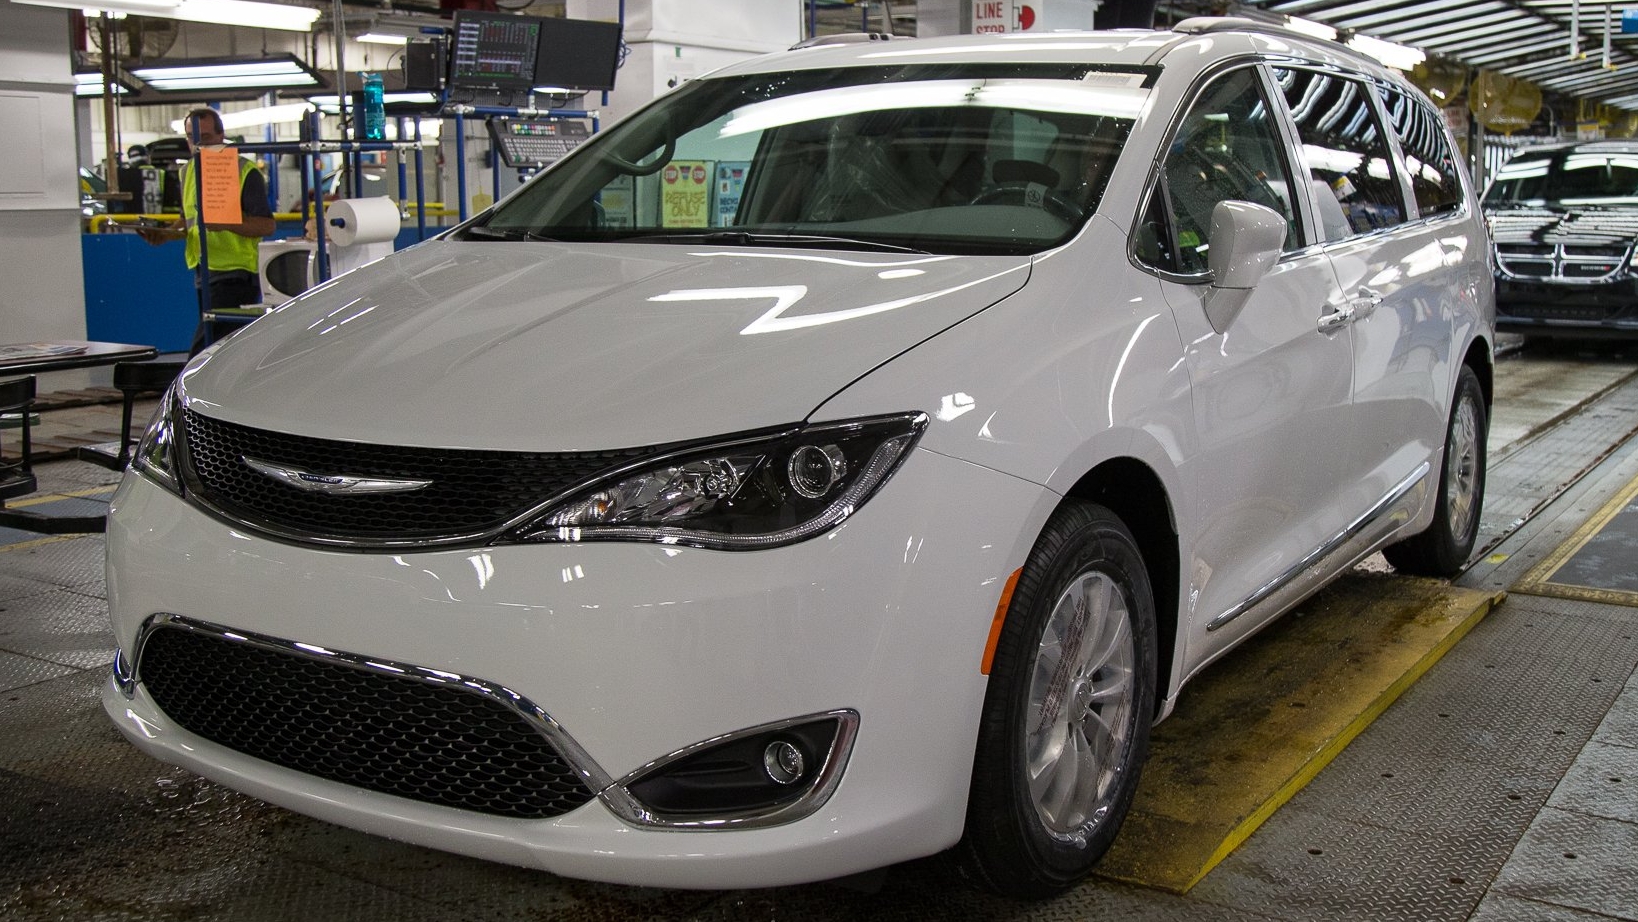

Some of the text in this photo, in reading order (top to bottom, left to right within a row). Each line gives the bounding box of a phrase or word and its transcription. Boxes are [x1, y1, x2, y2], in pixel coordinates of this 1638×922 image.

[976, 2, 1003, 19] LINE
[665, 191, 706, 204] REFUSE
[672, 204, 701, 217] ONLY
